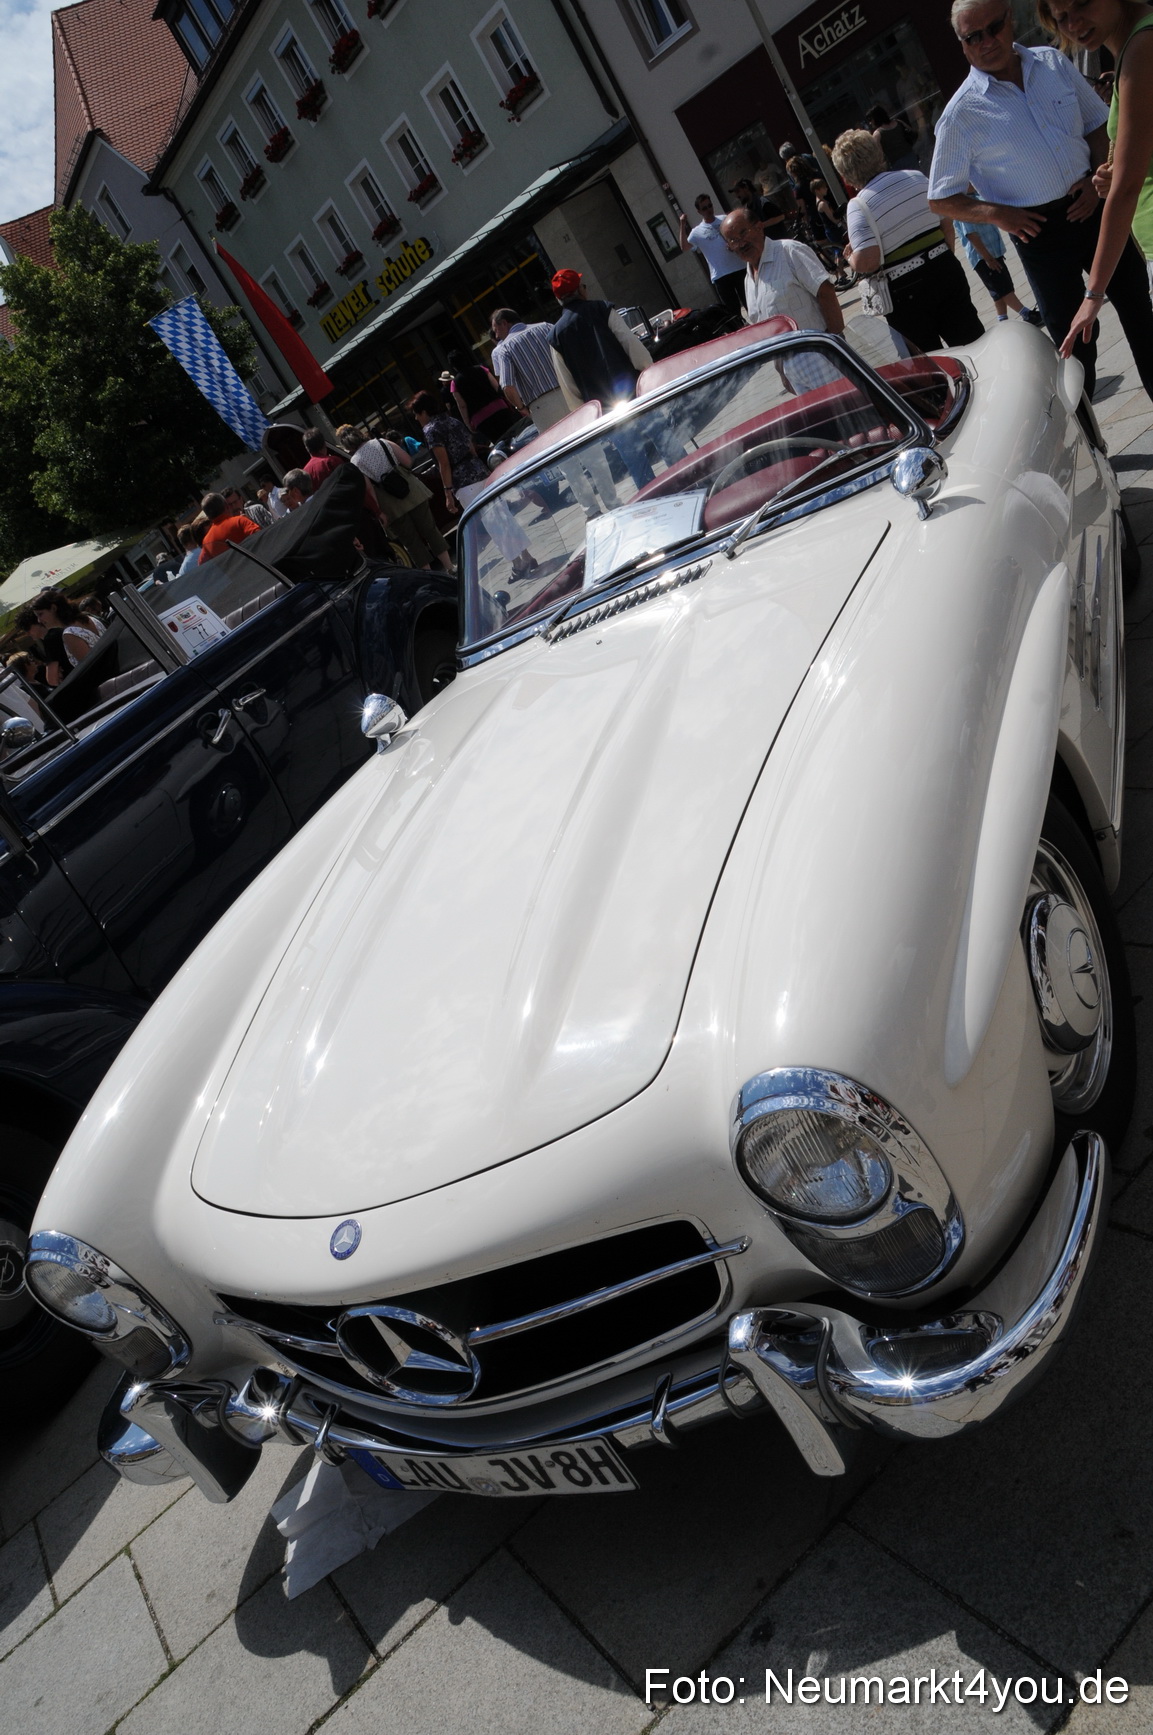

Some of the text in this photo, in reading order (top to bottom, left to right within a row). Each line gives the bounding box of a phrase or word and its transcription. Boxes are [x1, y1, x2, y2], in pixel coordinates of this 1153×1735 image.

[798, 4, 866, 69] Achatz
[319, 237, 434, 344] mayer schuhe
[192, 623, 209, 640] 77
[373, 1445, 629, 1492] LAU JV 8H
